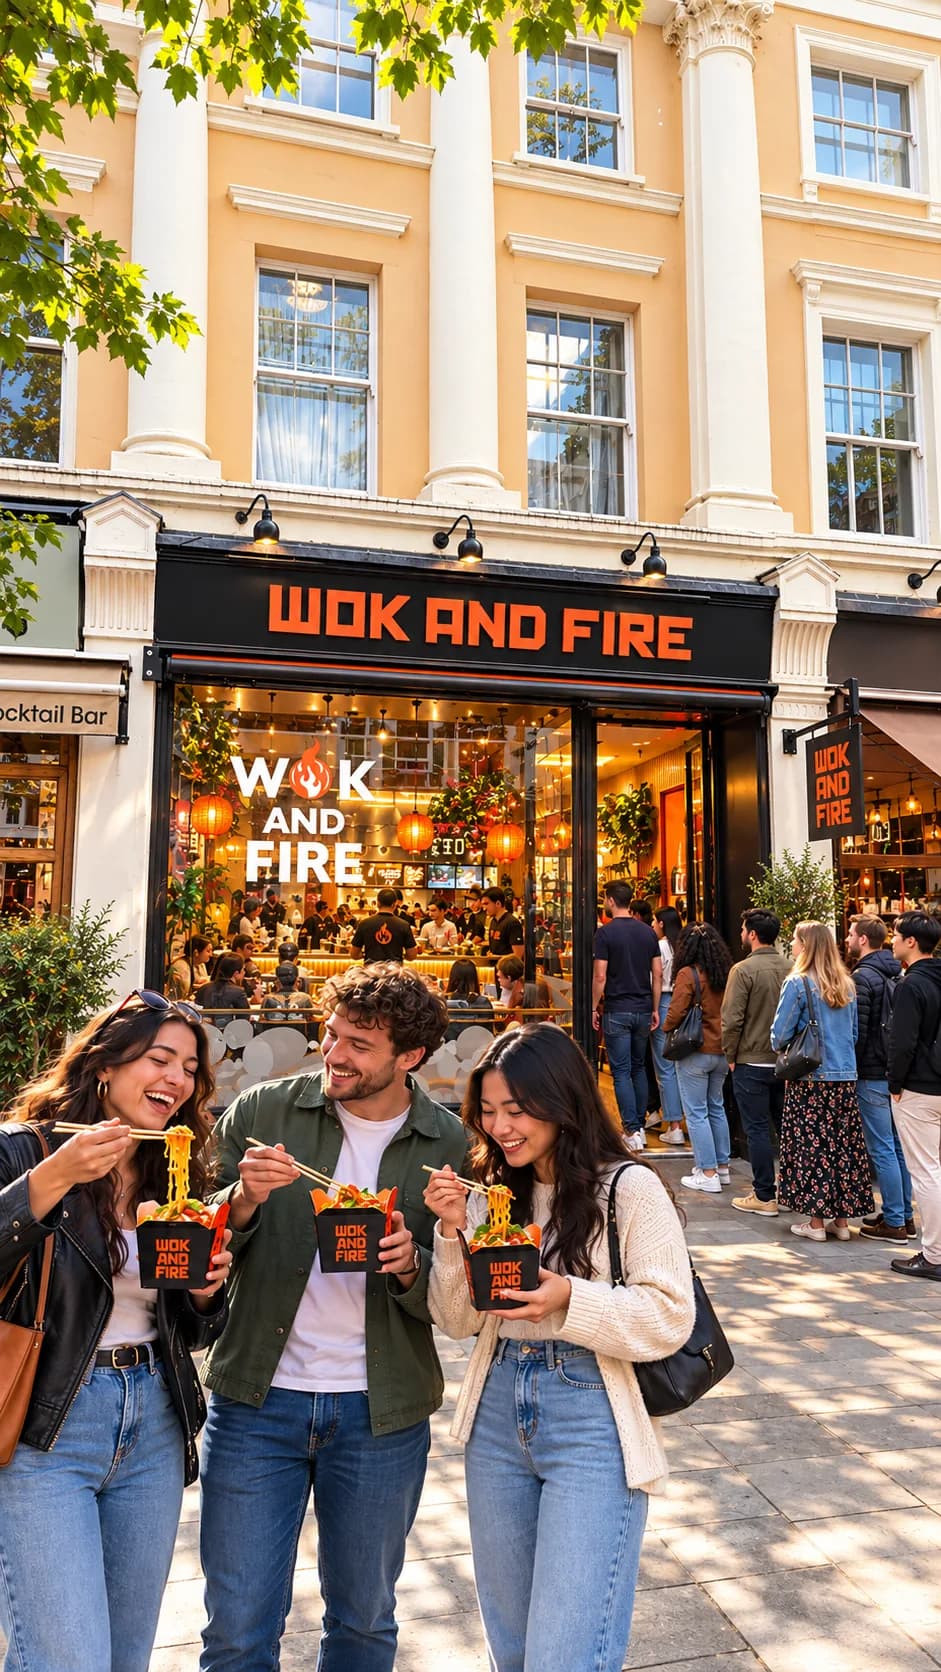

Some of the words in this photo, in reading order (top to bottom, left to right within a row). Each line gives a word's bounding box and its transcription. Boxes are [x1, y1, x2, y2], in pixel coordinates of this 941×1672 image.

[269, 584, 410, 642] WOK
[426, 597, 547, 651] AND
[562, 608, 694, 661] FIRE
[71, 706, 107, 725] Bar
[814, 741, 850, 774] WOK
[816, 770, 850, 801] AND
[816, 798, 853, 829] FIRE
[262, 807, 345, 835] AND
[246, 840, 363, 884] FIRE
[335, 1224, 367, 1237] WOK
[155, 1238, 190, 1252] WOK
[337, 1237, 366, 1249] AND
[157, 1252, 188, 1265] AND
[335, 1250, 367, 1262] FIRE
[155, 1266, 189, 1279] FIRE
[490, 1261, 521, 1275] WOK
[491, 1274, 521, 1287] AND
